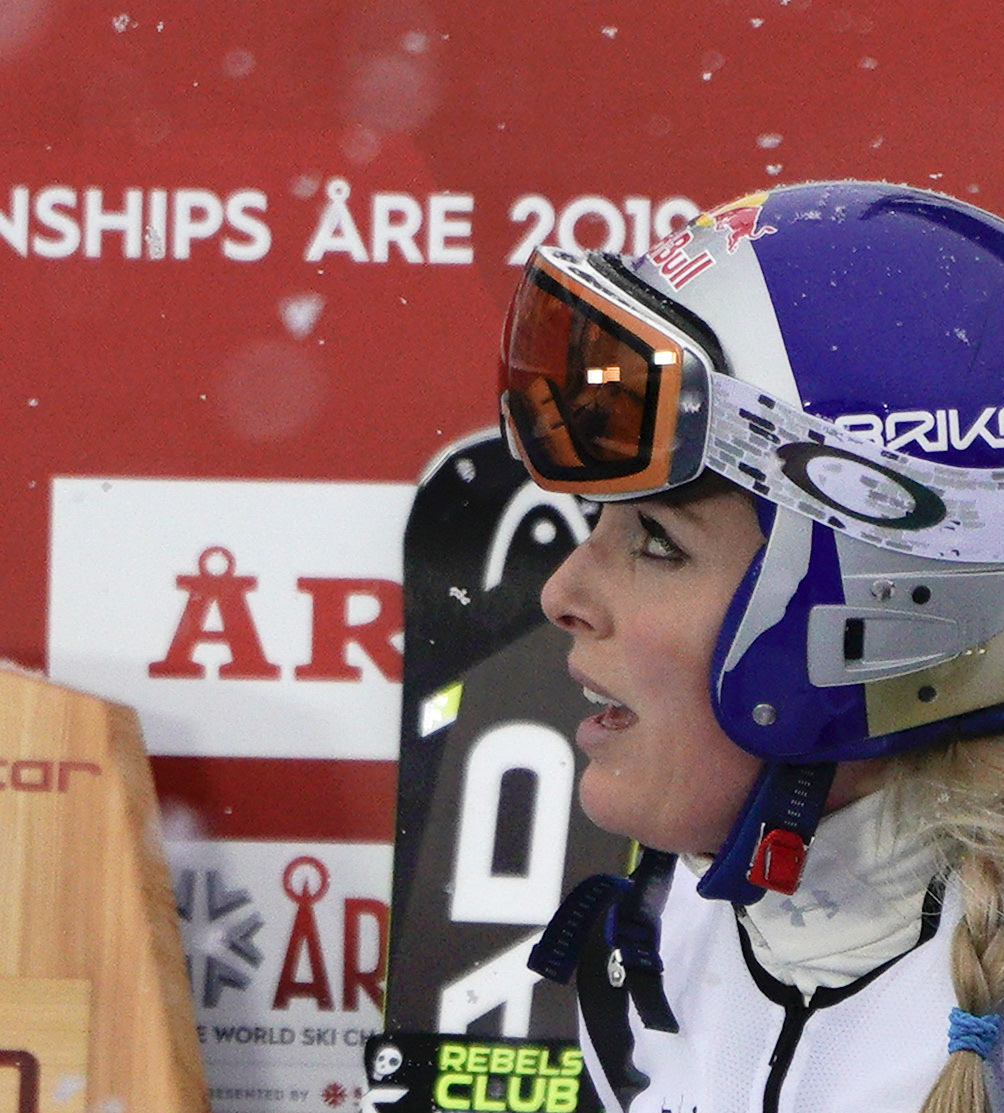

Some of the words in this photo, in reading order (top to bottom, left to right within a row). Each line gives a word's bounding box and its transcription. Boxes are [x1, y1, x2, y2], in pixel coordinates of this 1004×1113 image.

[305, 177, 474, 264] ÅRE
[213, 1026, 295, 1046] WORLD
[302, 1028, 337, 1047] SKI
[440, 1045, 583, 1076] REBELS
[436, 1073, 579, 1113] CLUB
